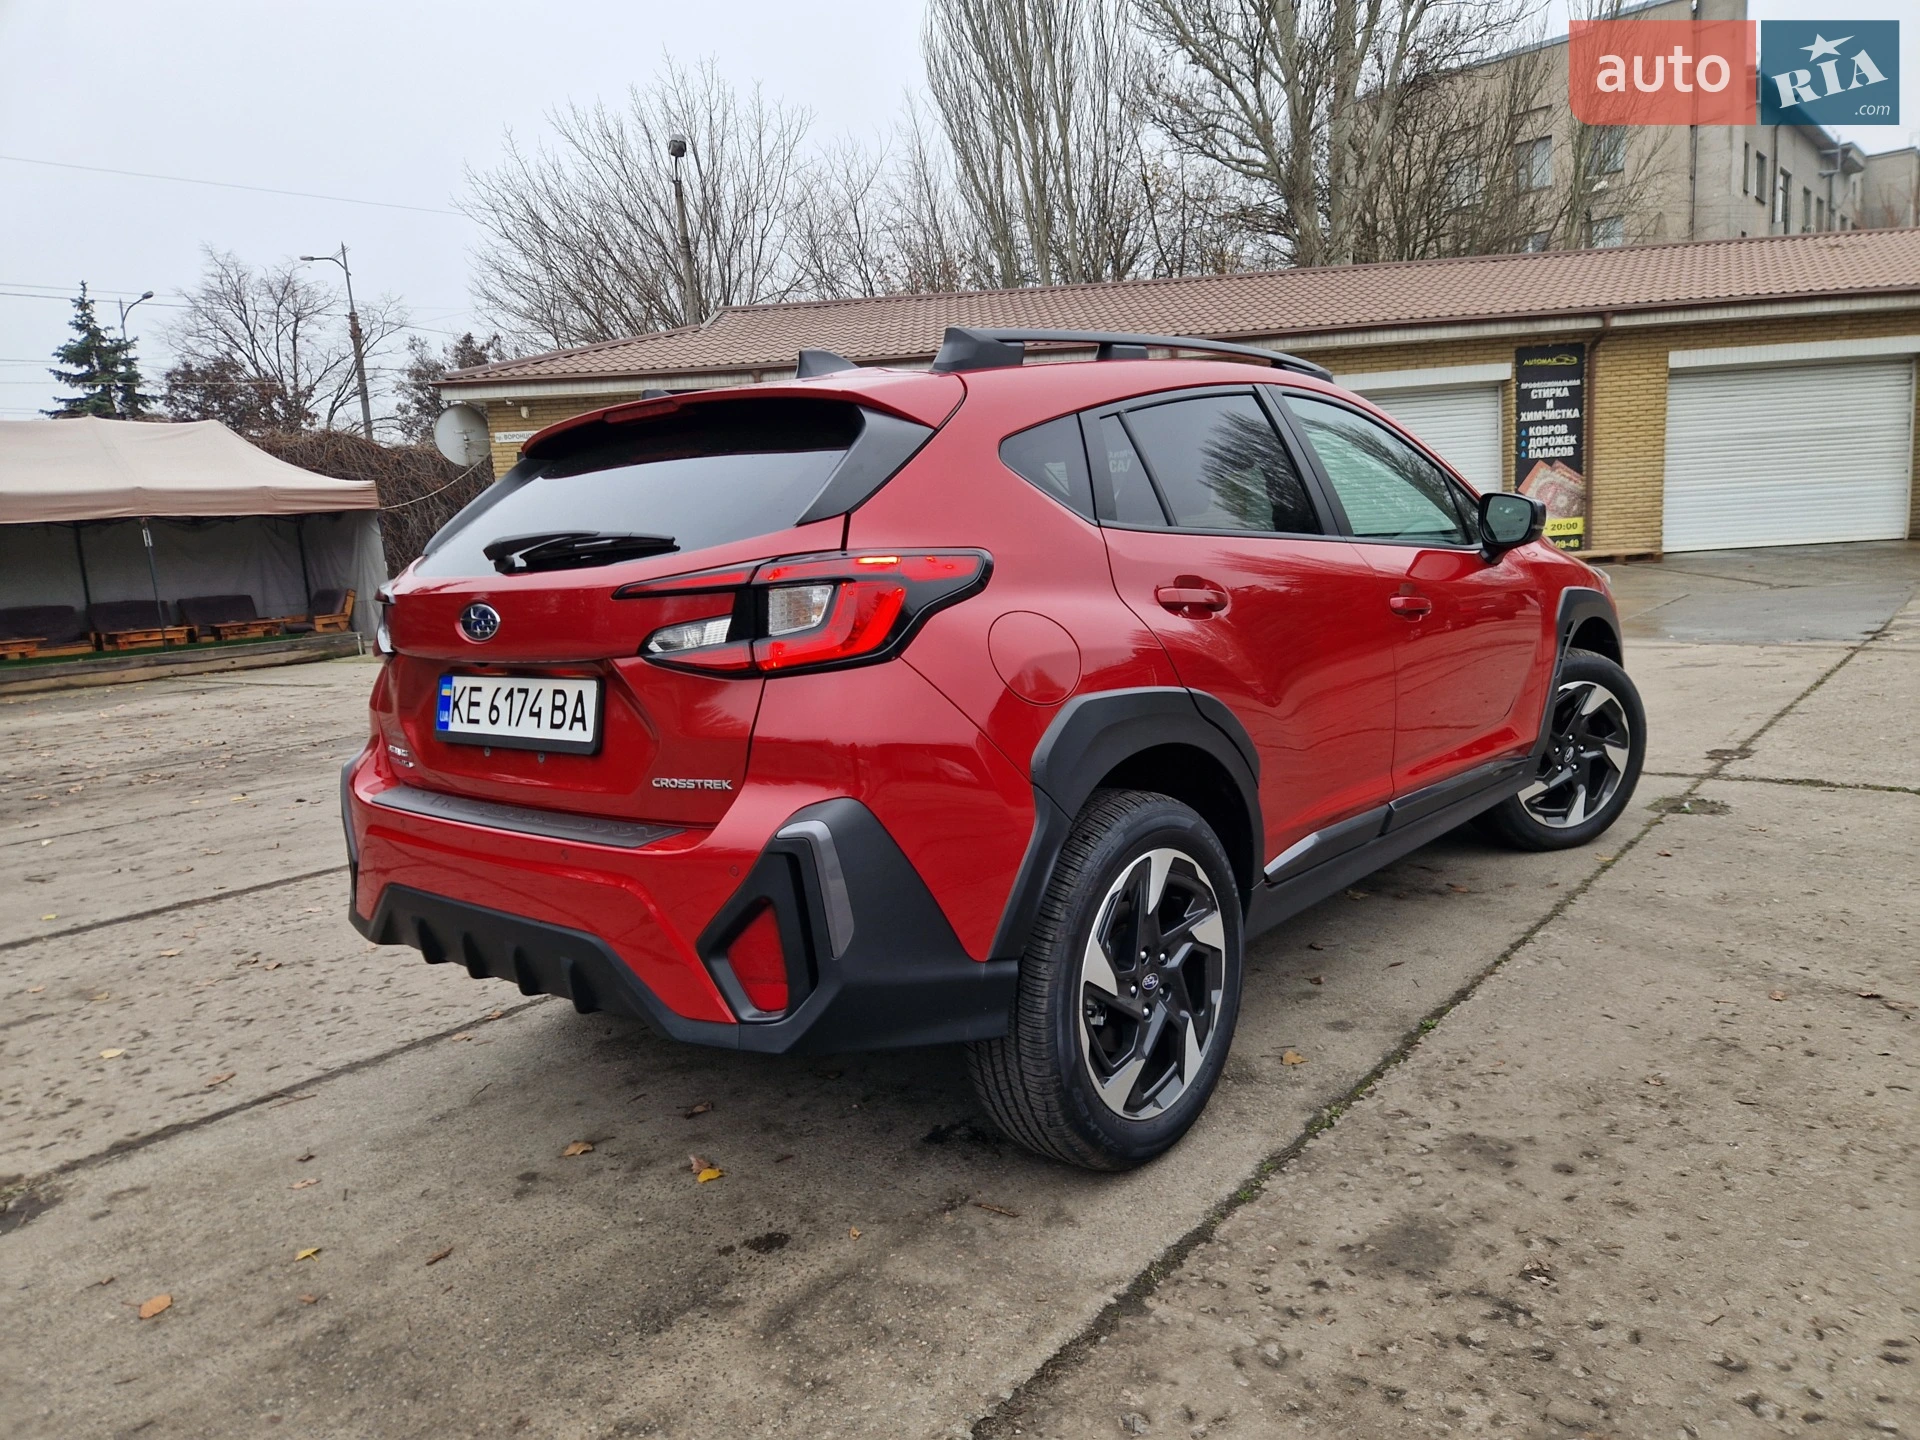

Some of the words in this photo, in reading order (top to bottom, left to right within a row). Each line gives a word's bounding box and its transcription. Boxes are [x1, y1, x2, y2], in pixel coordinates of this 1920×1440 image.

[1523, 357, 1557, 366] AUTOMAX
[1521, 379, 1580, 389] ПРОФЕССИОНАЛЬНАЯ
[1530, 387, 1570, 399] СТИРКА
[1546, 399, 1554, 409] И
[1520, 408, 1580, 422] ХИМЧИСТКА
[1528, 424, 1568, 437] КОВРОВ
[1528, 435, 1577, 449] ДОРОЖЕК
[1528, 446, 1574, 459] ПАЛАСОВ
[1550, 522, 1578, 531] 20:00
[452, 686, 482, 724] KE
[488, 687, 543, 728] 6174
[550, 689, 587, 731] BA
[440, 711, 449, 722] UA
[652, 777, 733, 790] CROSSTREK
